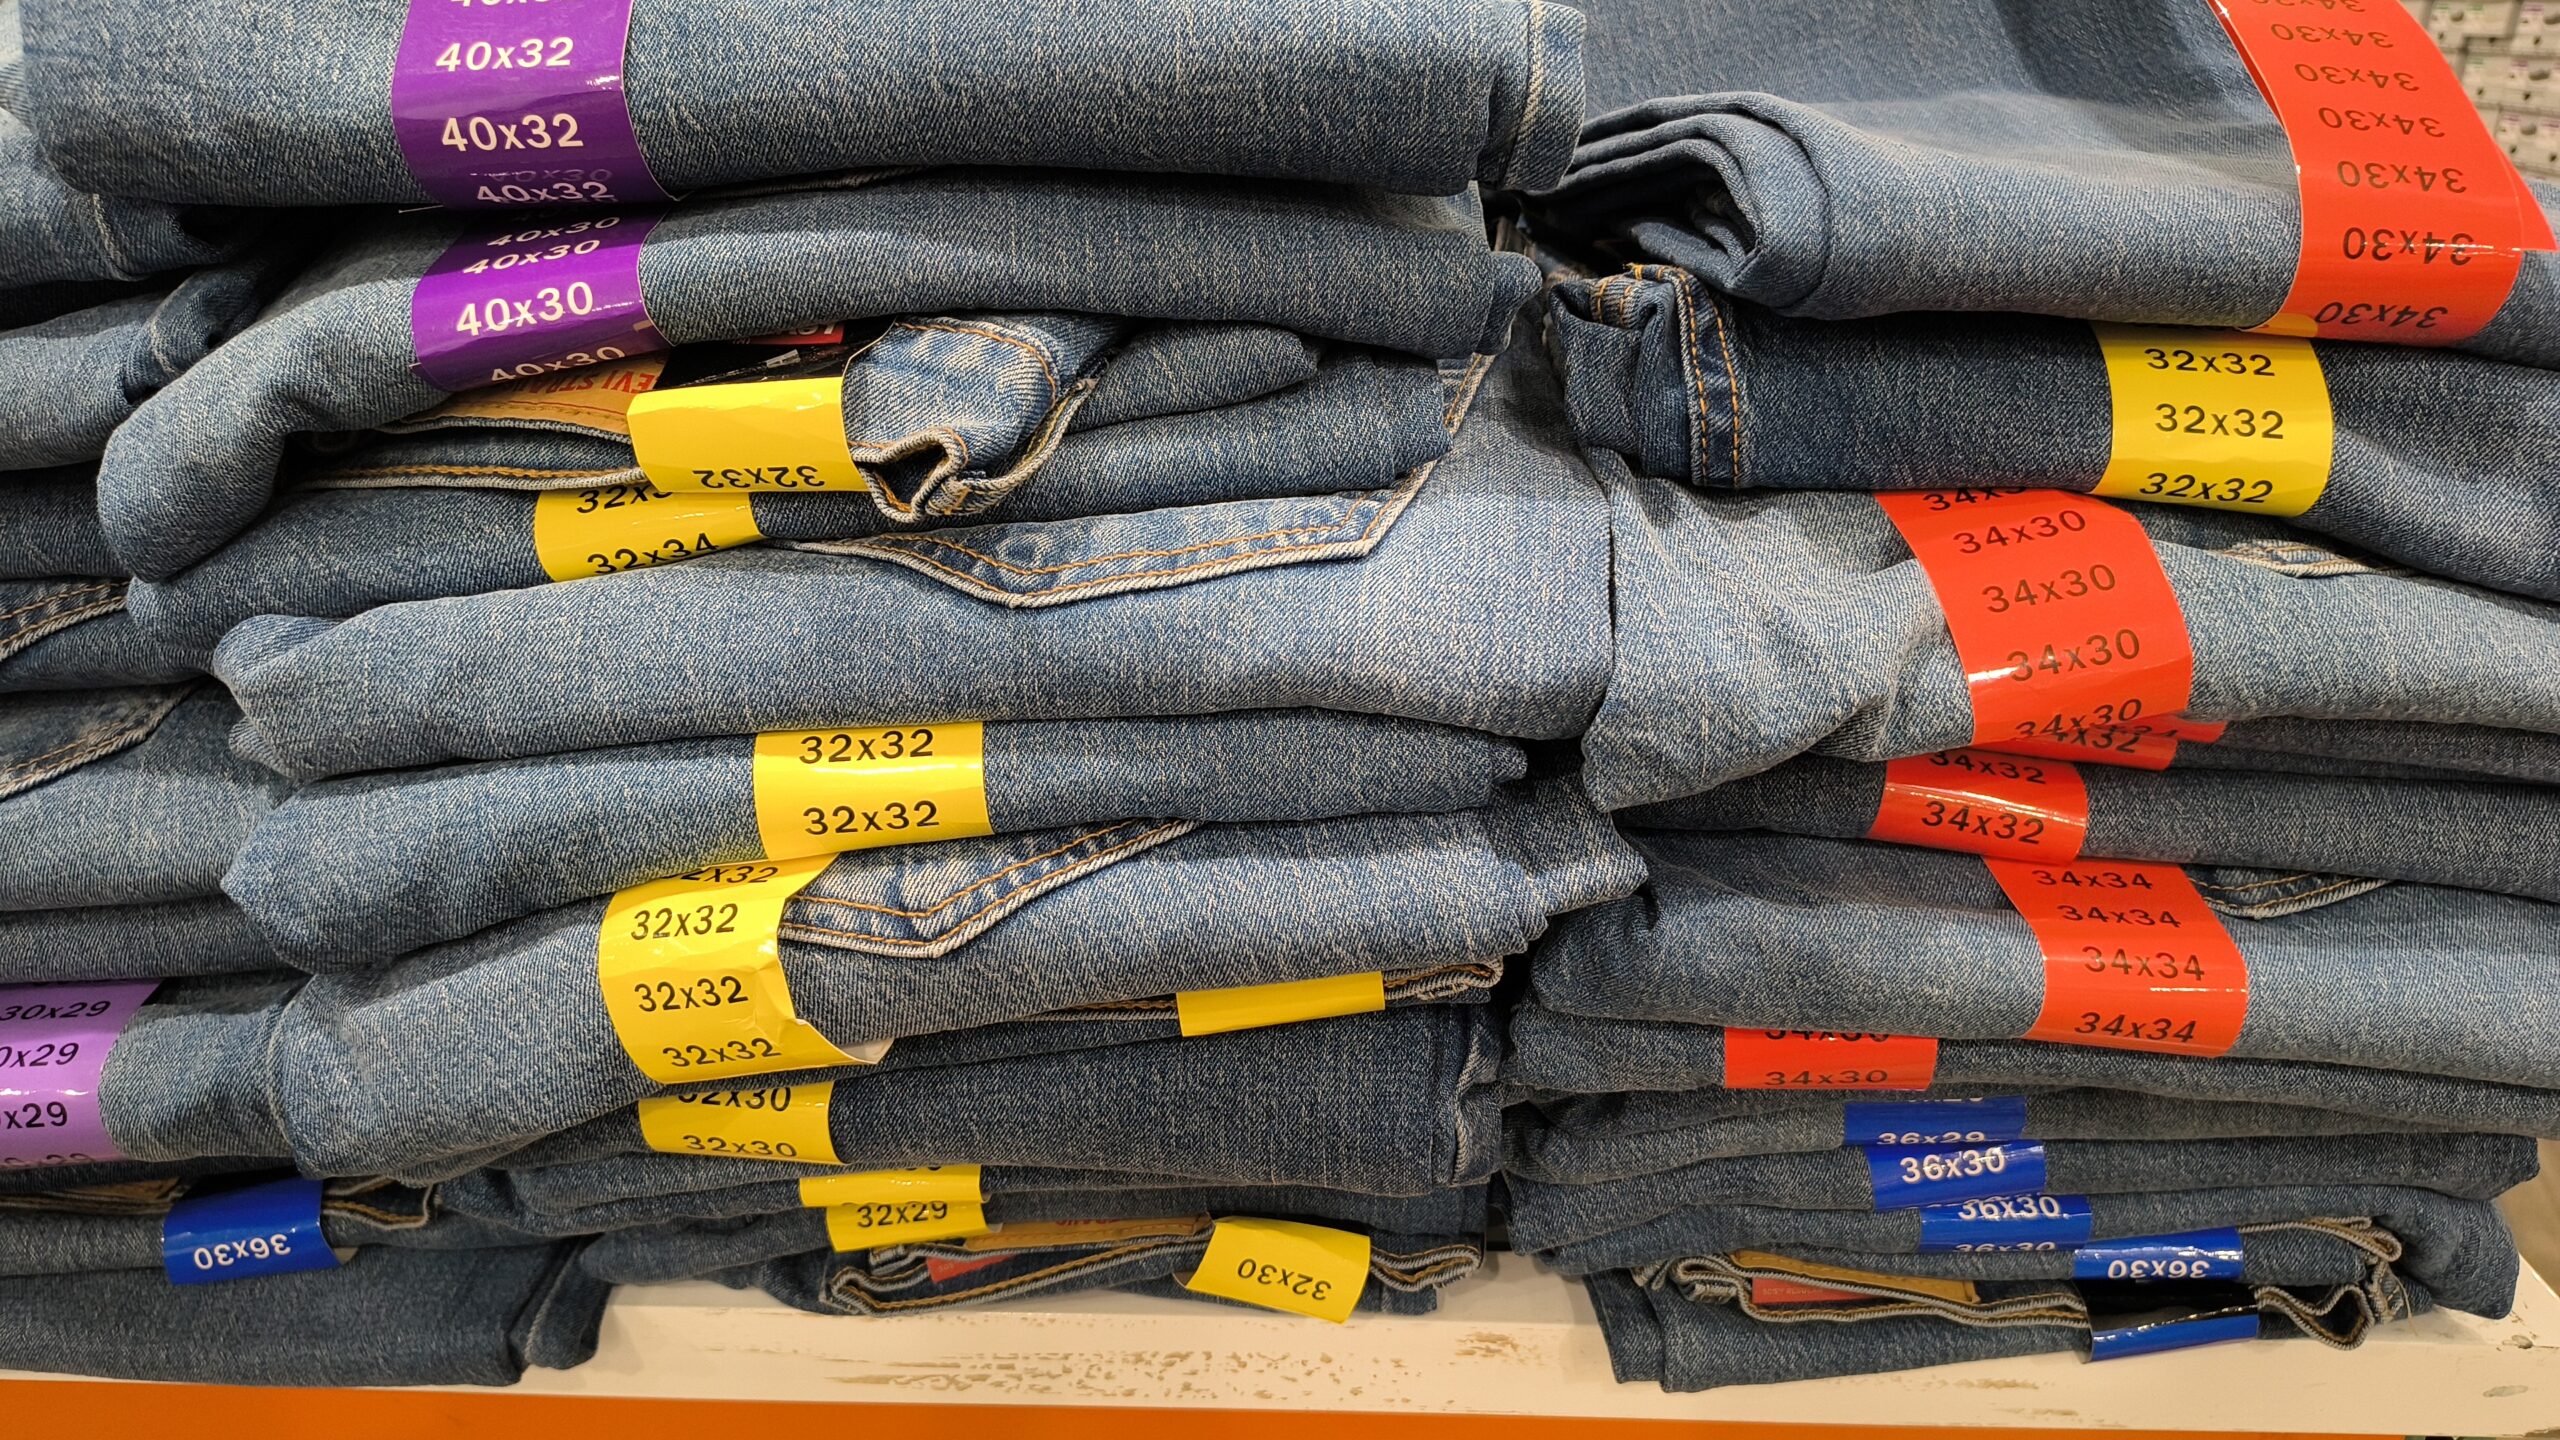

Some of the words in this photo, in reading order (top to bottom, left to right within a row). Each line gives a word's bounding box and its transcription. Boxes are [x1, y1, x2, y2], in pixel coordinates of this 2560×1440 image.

[2270, 23, 2394, 49] 34x30
[436, 37, 574, 72] 40x32
[2294, 63, 2420, 92] 34x30
[442, 113, 584, 152] 40x32
[2318, 107, 2446, 138] 34x30
[476, 181, 615, 203] 40x32
[2337, 160, 2467, 194] 34x30
[487, 217, 620, 246] 40x30
[2343, 227, 2475, 266] 34x30
[463, 239, 601, 275] 40x30
[456, 281, 593, 336] 40x30
[2315, 301, 2448, 329] 34x30
[491, 346, 626, 382] 40x30
[2144, 348, 2276, 376] 32x32
[2154, 403, 2284, 439] 32x32
[692, 465, 826, 489] 32x32
[2139, 472, 2273, 503] 32x32
[1953, 510, 2086, 554] 34x30
[587, 532, 719, 574] 32x34
[1982, 564, 2116, 613] 34x30
[2007, 628, 2140, 682] 34x30
[799, 728, 934, 764] 32x32
[1929, 751, 2048, 784] 34x32
[802, 800, 940, 835] 32x32
[1921, 800, 2045, 845] 34x32
[2031, 870, 2153, 889] 34x34
[630, 903, 738, 941] 32x32
[2057, 905, 2182, 928] 34x34
[2082, 946, 2205, 982] 34x34
[0, 1001, 111, 1021] 30x29
[634, 976, 748, 1013] 32x32
[2074, 1011, 2197, 1043] 34x34
[662, 1037, 782, 1068] 32x32
[1765, 1069, 1889, 1086] 34x30
[0, 1101, 67, 1129] x29
[682, 1134, 798, 1158] 32x30
[1900, 1147, 2006, 1184] 36x30
[857, 1202, 948, 1228] 32x29
[193, 1233, 292, 1271] 36x30
[2108, 1259, 2211, 1279] 36x30
[1237, 1258, 1332, 1301] 32x30
